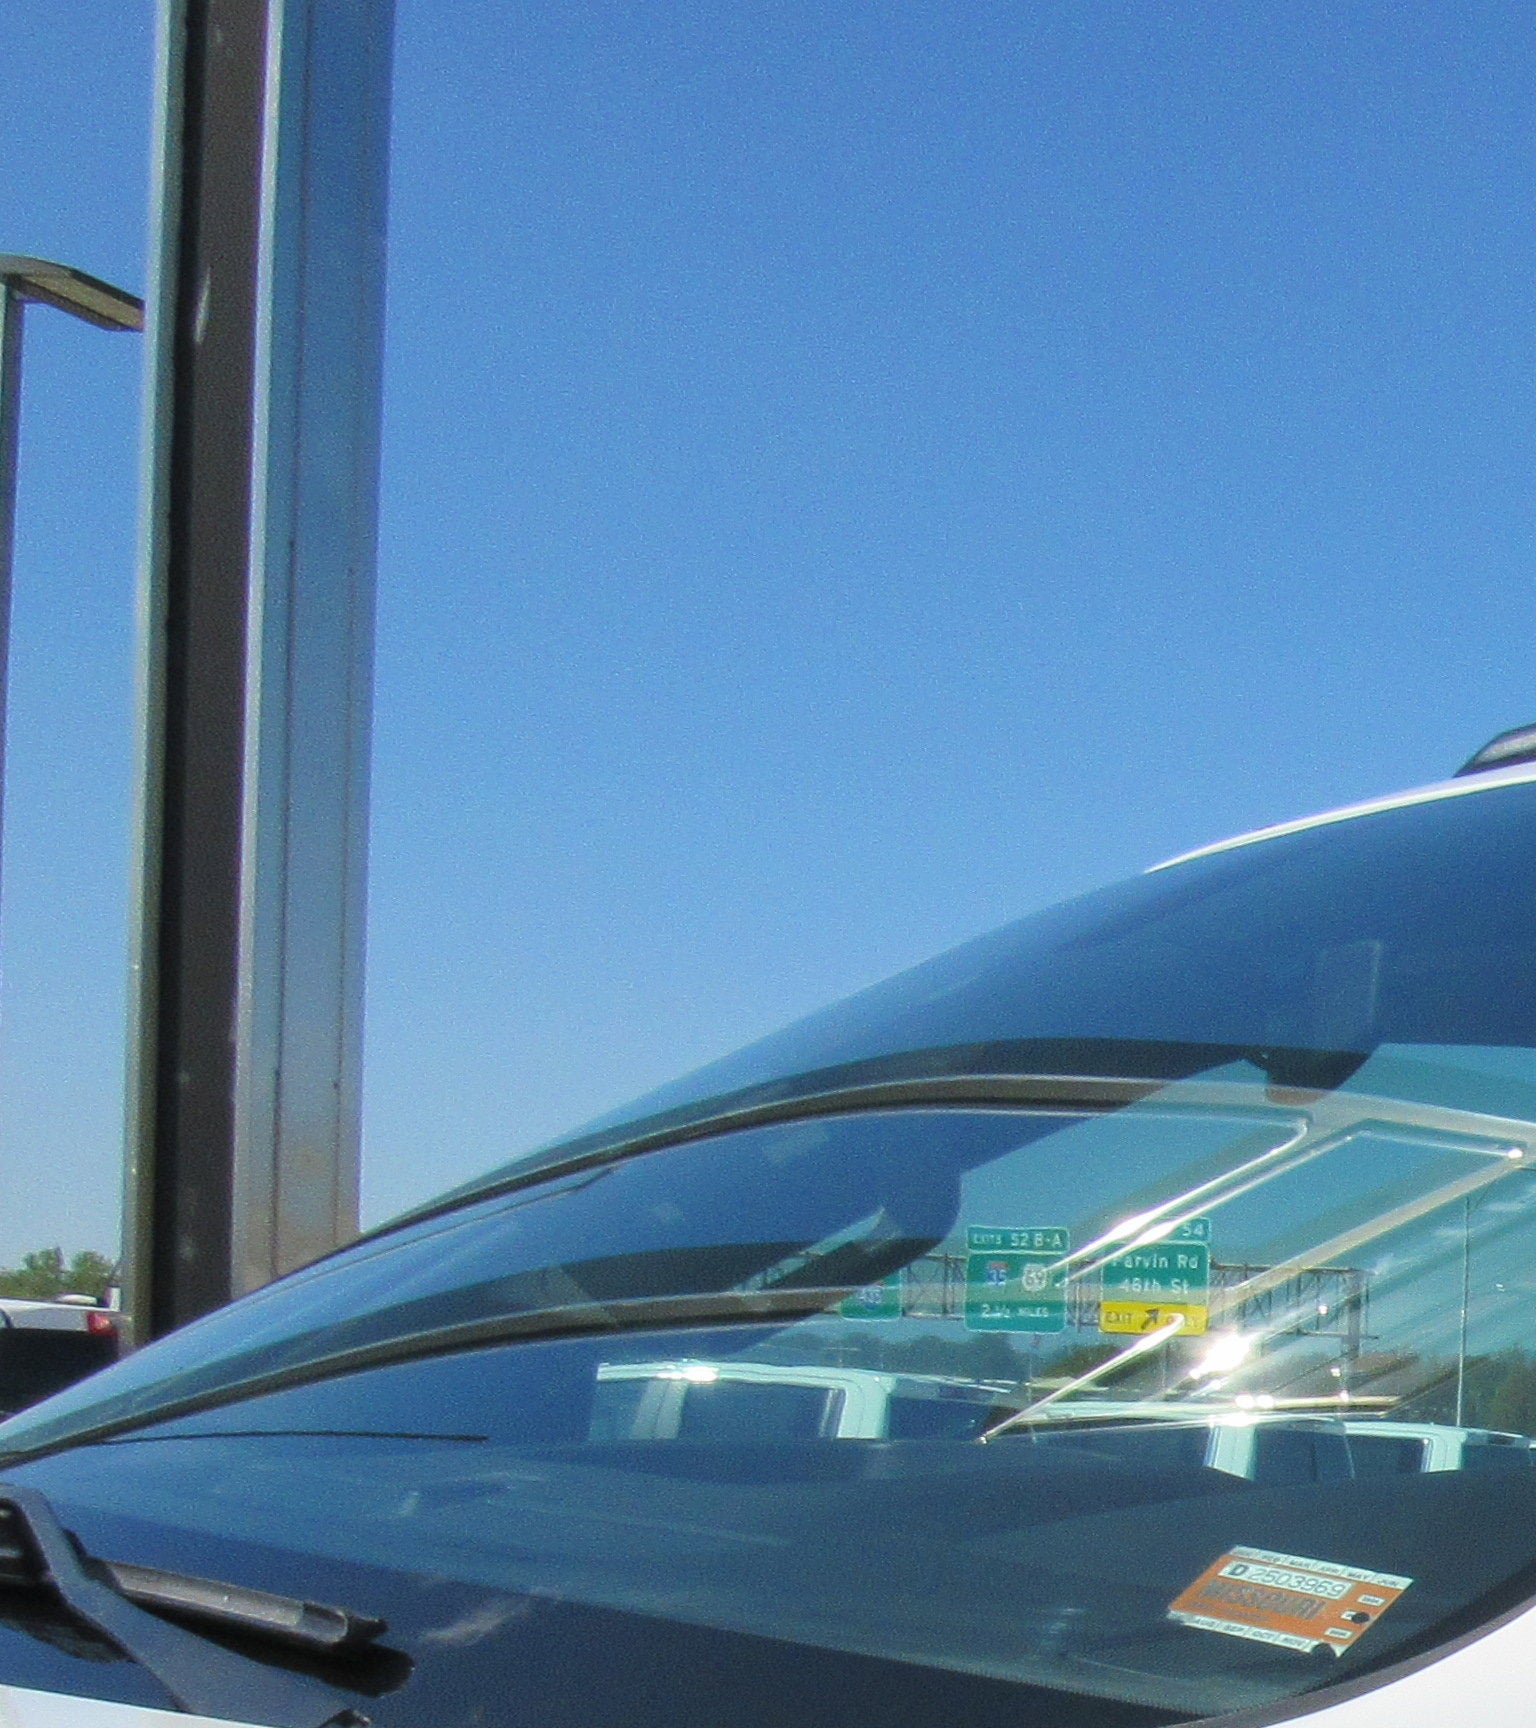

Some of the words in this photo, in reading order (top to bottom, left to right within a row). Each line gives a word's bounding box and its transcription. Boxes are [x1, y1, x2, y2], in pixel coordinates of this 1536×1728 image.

[1010, 1233, 1029, 1247] 52
[1176, 1254, 1199, 1269] Rd
[1170, 1278, 1190, 1294] St
[1228, 1564, 1249, 1577] D
